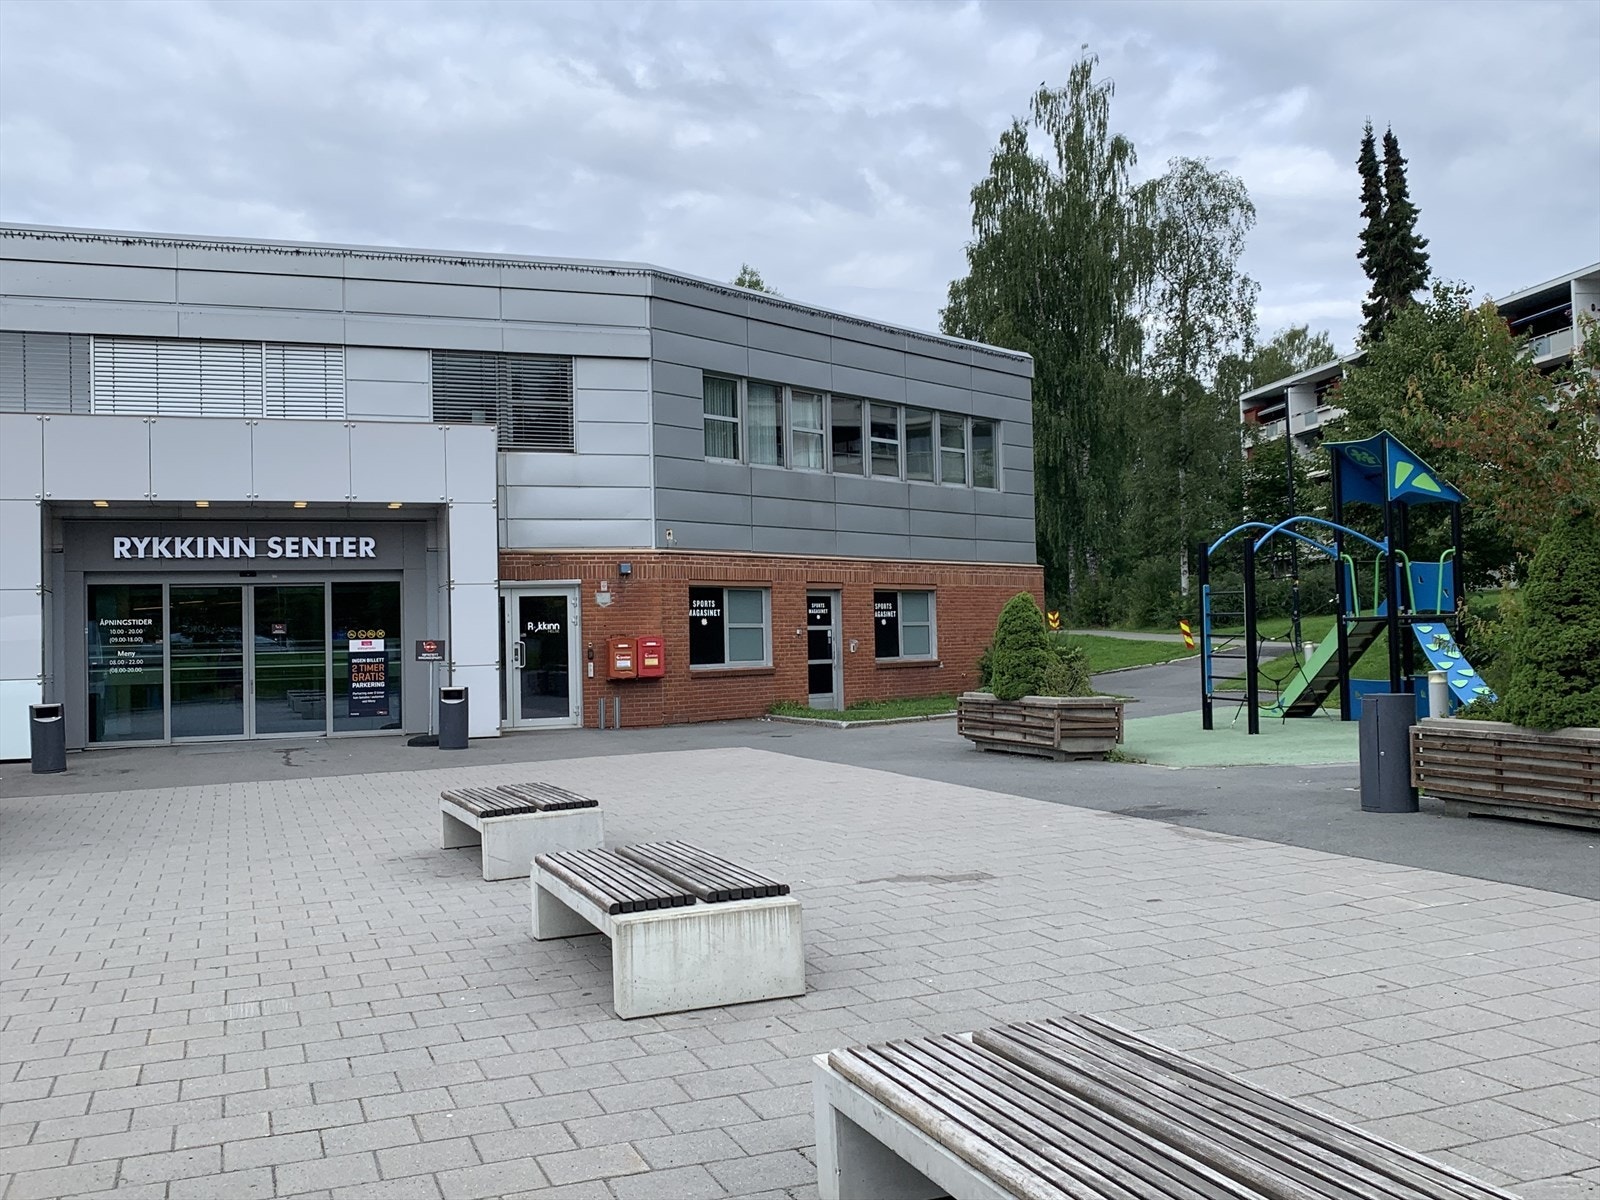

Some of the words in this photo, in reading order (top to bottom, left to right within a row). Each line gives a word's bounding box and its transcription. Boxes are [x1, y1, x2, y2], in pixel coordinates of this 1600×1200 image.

[113, 536, 256, 559] RYKKINN
[267, 536, 377, 559] SENTER
[692, 600, 715, 608] SPORTS
[874, 602, 892, 610] SPORTS
[99, 618, 153, 626] ÅPNINGSTIDER
[117, 650, 136, 658] Meny
[351, 664, 358, 673] 2
[359, 663, 385, 672] TIMER
[351, 672, 385, 682] GRATIS
[351, 681, 385, 689] PARKERING
